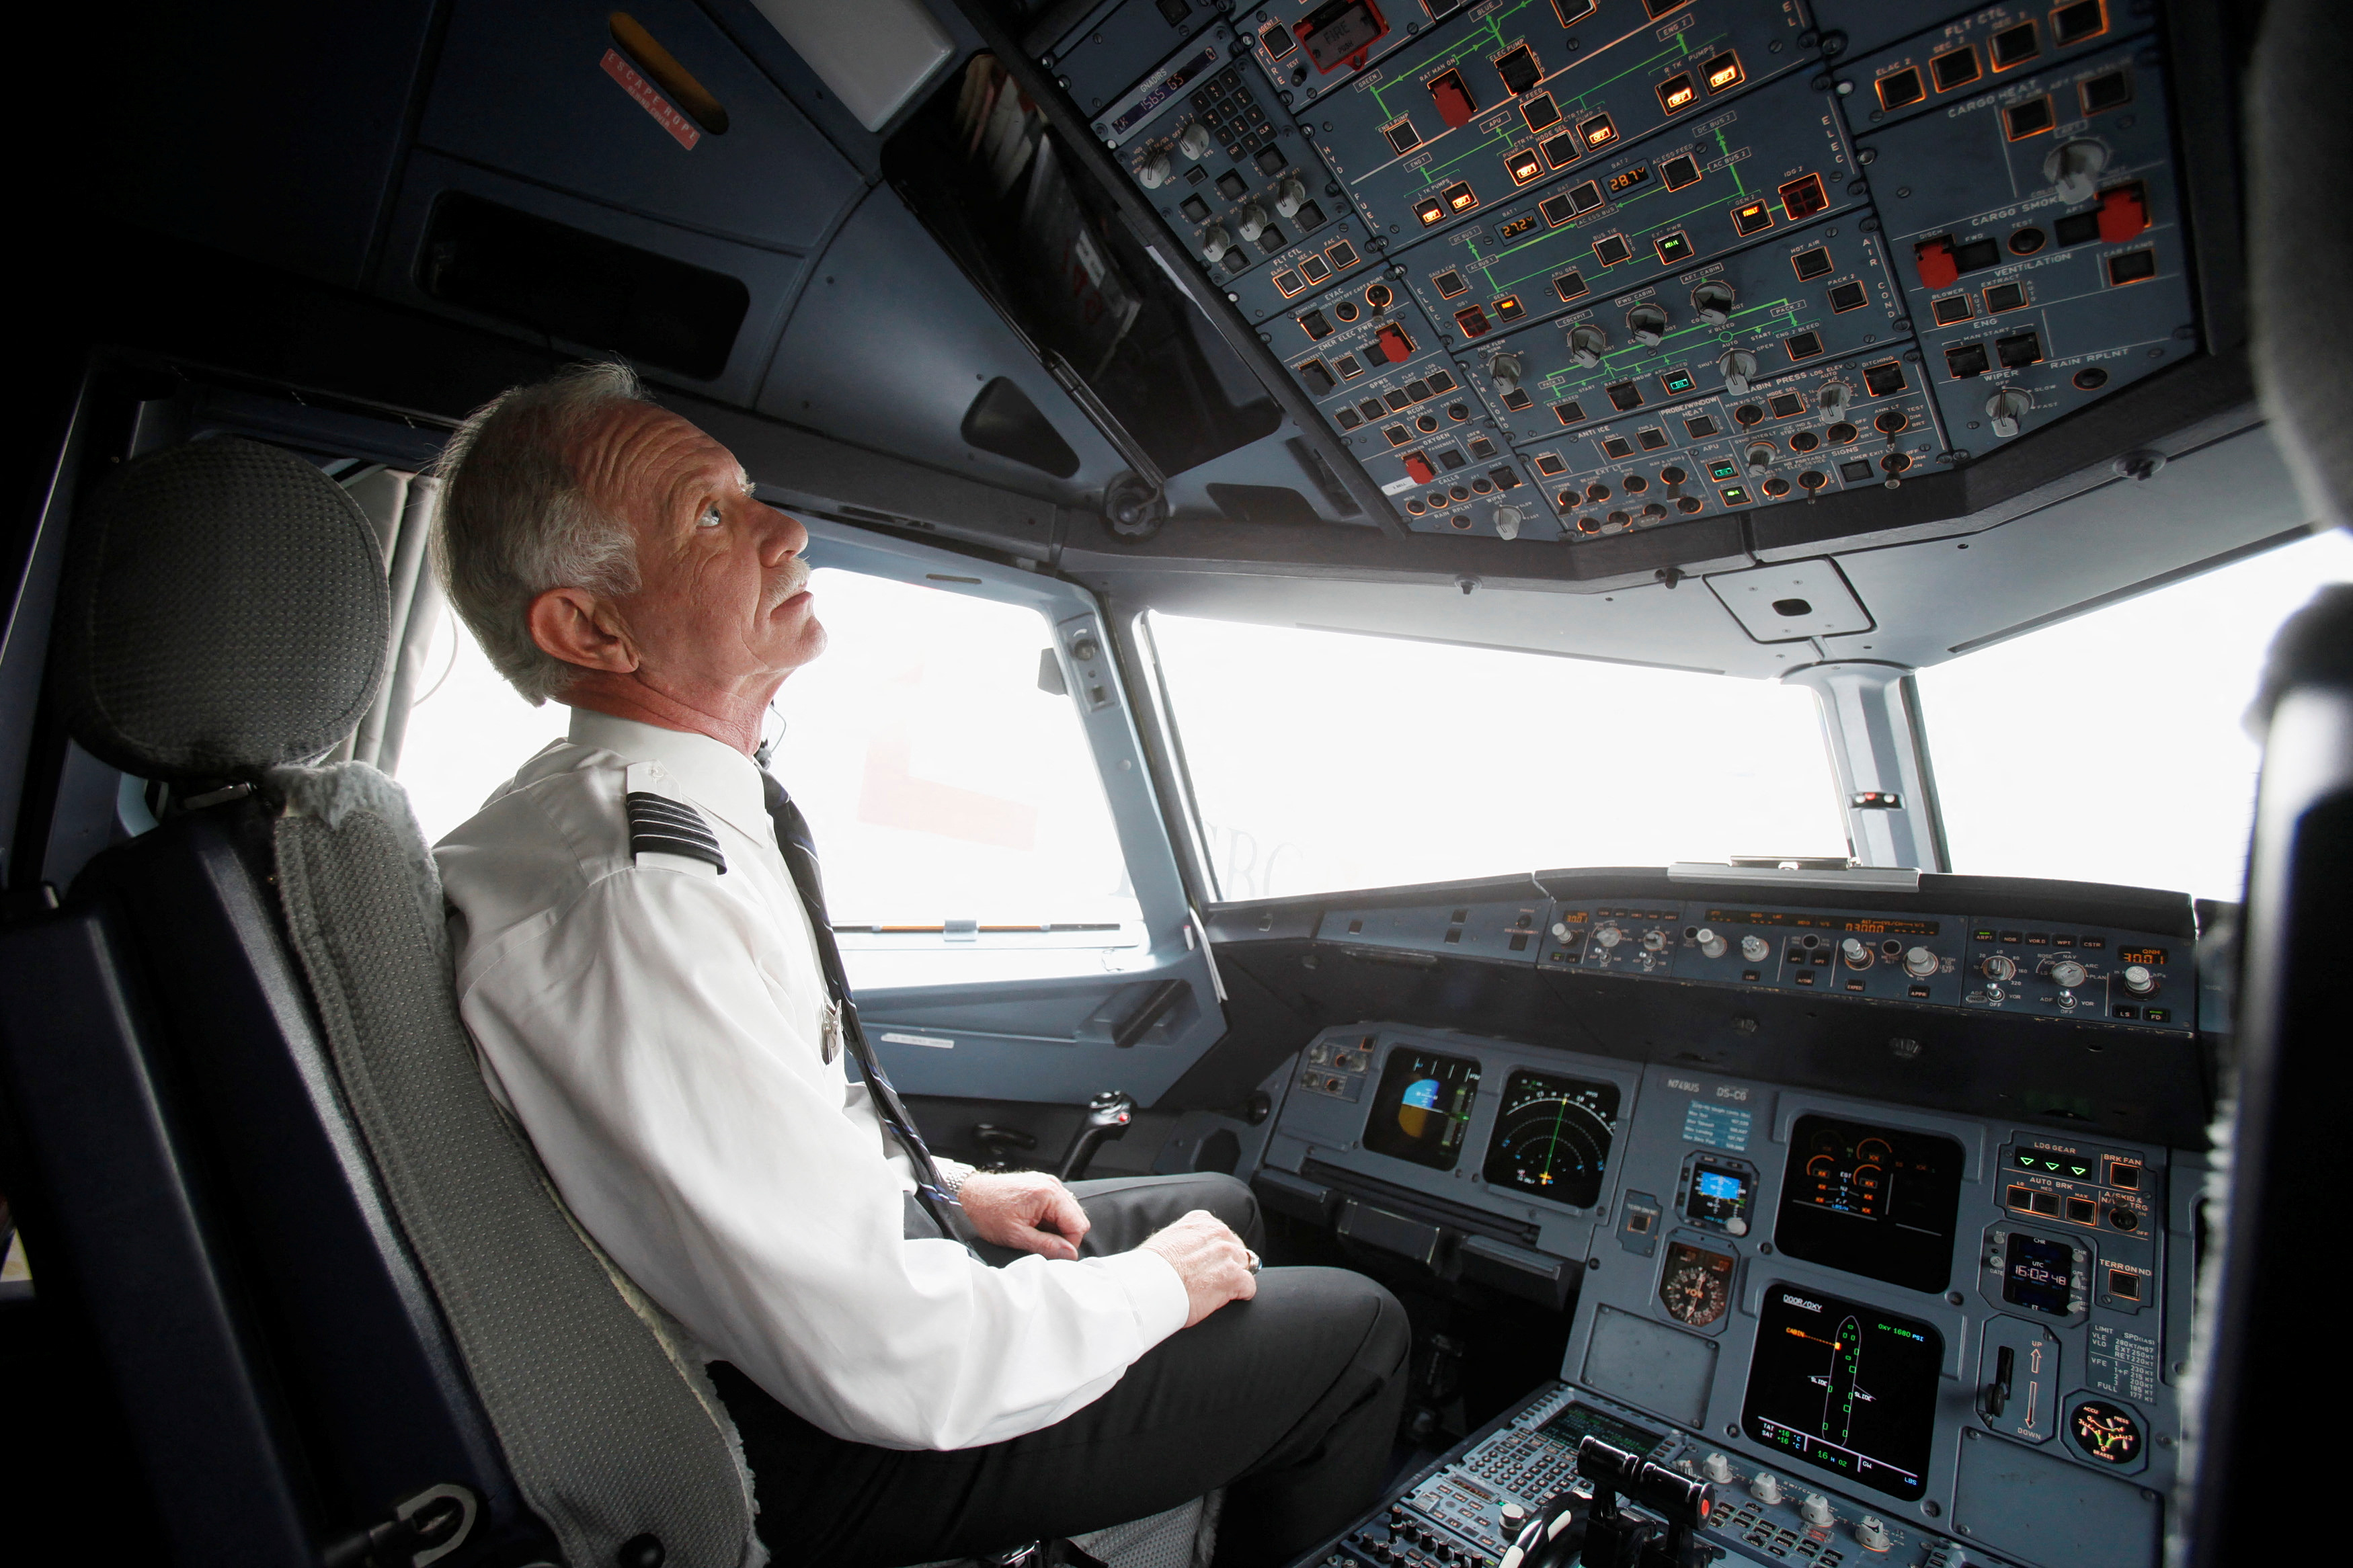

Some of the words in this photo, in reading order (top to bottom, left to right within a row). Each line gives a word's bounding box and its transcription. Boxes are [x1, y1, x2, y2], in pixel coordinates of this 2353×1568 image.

[1476, 2, 1494, 16] BLUE
[1322, 21, 1351, 44] FIRE
[1662, 26, 1679, 36] ENG
[1489, 51, 1506, 61] ELEC
[1506, 39, 1525, 53] PUMP
[1688, 44, 1714, 61] PUMPS
[1287, 58, 1300, 70] TEST
[1419, 71, 1432, 82] RAT
[1433, 63, 1445, 74] MAN
[1447, 58, 1456, 66] ON
[1140, 69, 1167, 93] GNADIRS
[1358, 74, 1378, 88] GREEN
[1714, 73, 1730, 83] OFF
[608, 53, 660, 105] ESCAPE
[664, 107, 696, 140] ROPE
[1525, 88, 1543, 100] FEED
[1948, 95, 1995, 118] CARGO
[1393, 113, 1408, 124] PUMP
[1489, 118, 1502, 128] APU
[1710, 119, 1724, 129] BUS
[1535, 130, 1553, 142] MODE
[1554, 125, 1566, 134] SEL
[1725, 155, 1741, 163] BUS
[1431, 179, 1449, 191] PUMPS
[1354, 192, 1379, 229] FUEL
[1743, 206, 1760, 216] FAULT
[1972, 208, 2016, 226] CARGO
[2022, 196, 2063, 212] SMOK
[1808, 240, 1821, 248] AIR
[1965, 234, 1983, 242] FWD
[1273, 254, 1287, 266] FLT
[1288, 248, 1302, 258] CTL
[1700, 265, 1720, 276] CABIN
[1995, 253, 2072, 277] VENTILATION
[1827, 277, 1847, 286] PACK
[1981, 274, 2020, 288] EXTRACT
[1324, 288, 1344, 301] EVAC
[1618, 296, 1633, 305] FWD
[1634, 289, 1653, 299] CABIN
[1932, 288, 1964, 300] BLOWER
[1562, 313, 1586, 324] COCKPIT
[1974, 319, 1998, 329] ENG
[1318, 341, 1341, 351] EMER
[1342, 332, 1357, 341] ELEC
[1358, 323, 1374, 333] PWR
[1964, 333, 1981, 341] MAN
[1983, 327, 2010, 337] START
[1756, 343, 1775, 351] OPEN
[1862, 356, 1895, 368] DITCHING
[2050, 358, 2080, 369] RAIN
[2087, 349, 2130, 362] RPLNT
[1776, 374, 1807, 384] PRESS
[1983, 370, 2019, 382] WIPER
[1406, 405, 1425, 415] RCDR
[1661, 397, 1717, 416] PROBE/WINDOW
[1682, 407, 1704, 417] HEAT
[1579, 429, 1596, 438] ANTI
[1597, 425, 1610, 434] ICE
[1423, 431, 1451, 446] OXYGEN
[1703, 444, 1718, 452] APU
[1831, 446, 1859, 456] SIGNS
[1439, 474, 1460, 485] CALLS
[1486, 493, 1507, 503] WIPER
[1434, 511, 1449, 519] RAIN
[1451, 504, 1473, 515] RPLNT
[2034, 1142, 2050, 1150] LDG
[2052, 1145, 2076, 1154] GEAR
[2124, 1157, 2141, 1165] FAN
[2030, 1177, 2052, 1186] AUTO
[2056, 1182, 2073, 1190] BRK
[2100, 1259, 2124, 1270] TERR
[2139, 1268, 2151, 1276] ND
[2051, 1276, 2067, 1286] 48
[1783, 1294, 1823, 1310] DOOR/OXY
[1786, 1327, 1805, 1337] CABIN
[1894, 1327, 1911, 1337] 1680
[1912, 1334, 1924, 1342] PSI
[2095, 1325, 2113, 1333] LIMIT
[2092, 1332, 2106, 1340] VLE
[2092, 1339, 2106, 1348] VLO
[2114, 1346, 2130, 1354] EXT
[2091, 1358, 2107, 1366] VFE
[2114, 1352, 2130, 1360] RET
[2130, 1372, 2143, 1380] 215
[2098, 1382, 2117, 1392] FULL
[2018, 1428, 2042, 1440] DOWN
[1818, 1450, 1828, 1459] 16
[1839, 1458, 1847, 1467] 02
[2093, 1449, 2115, 1460] BRAKES
[1863, 1460, 1872, 1469] GW
